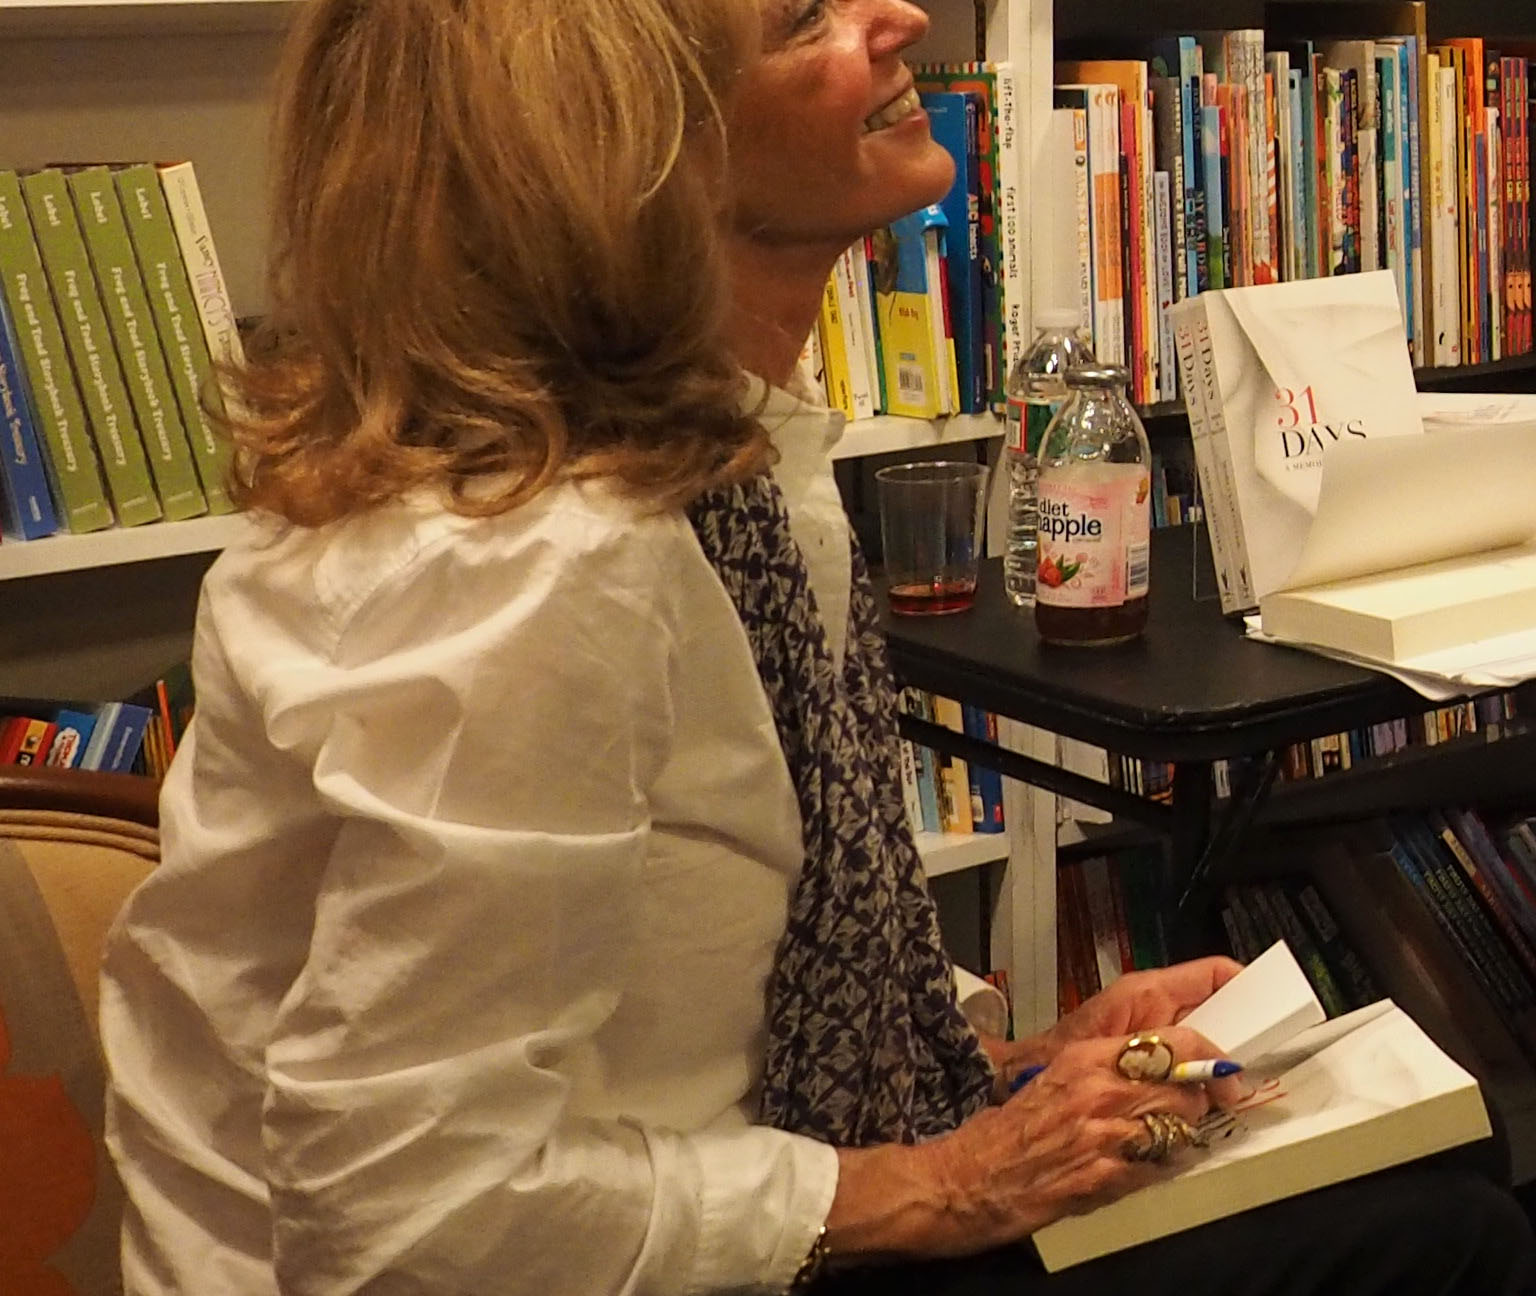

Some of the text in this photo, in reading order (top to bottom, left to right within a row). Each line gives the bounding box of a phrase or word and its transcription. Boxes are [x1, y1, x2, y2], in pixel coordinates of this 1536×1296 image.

[1001, 77, 1014, 149] lift-the-flap
[1435, 160, 1441, 170] Up
[1005, 186, 1018, 278] first 100 animals
[1158, 191, 1167, 229] AWESOME
[1159, 232, 1168, 254] BOOK
[1173, 155, 1185, 272] Kitten's First Full
[1195, 190, 1207, 288] MY GARDEN
[1388, 225, 1396, 250] Found
[153, 261, 187, 343] Frog and Toad
[1008, 303, 1020, 336] Roger
[13, 272, 79, 473] Frog and Toad Storybook Treasury
[61, 269, 129, 466] Frog and Toad Storybook Treasury
[109, 265, 175, 462] Frog and Toad Storybook Treasury
[1177, 325, 1202, 407] 31 Days
[1195, 320, 1219, 401] 31 Days
[1275, 384, 1321, 430] 31
[1278, 419, 1367, 459] DAYS
[1292, 460, 1323, 471] MEMOI
[1039, 500, 1069, 518] diet
